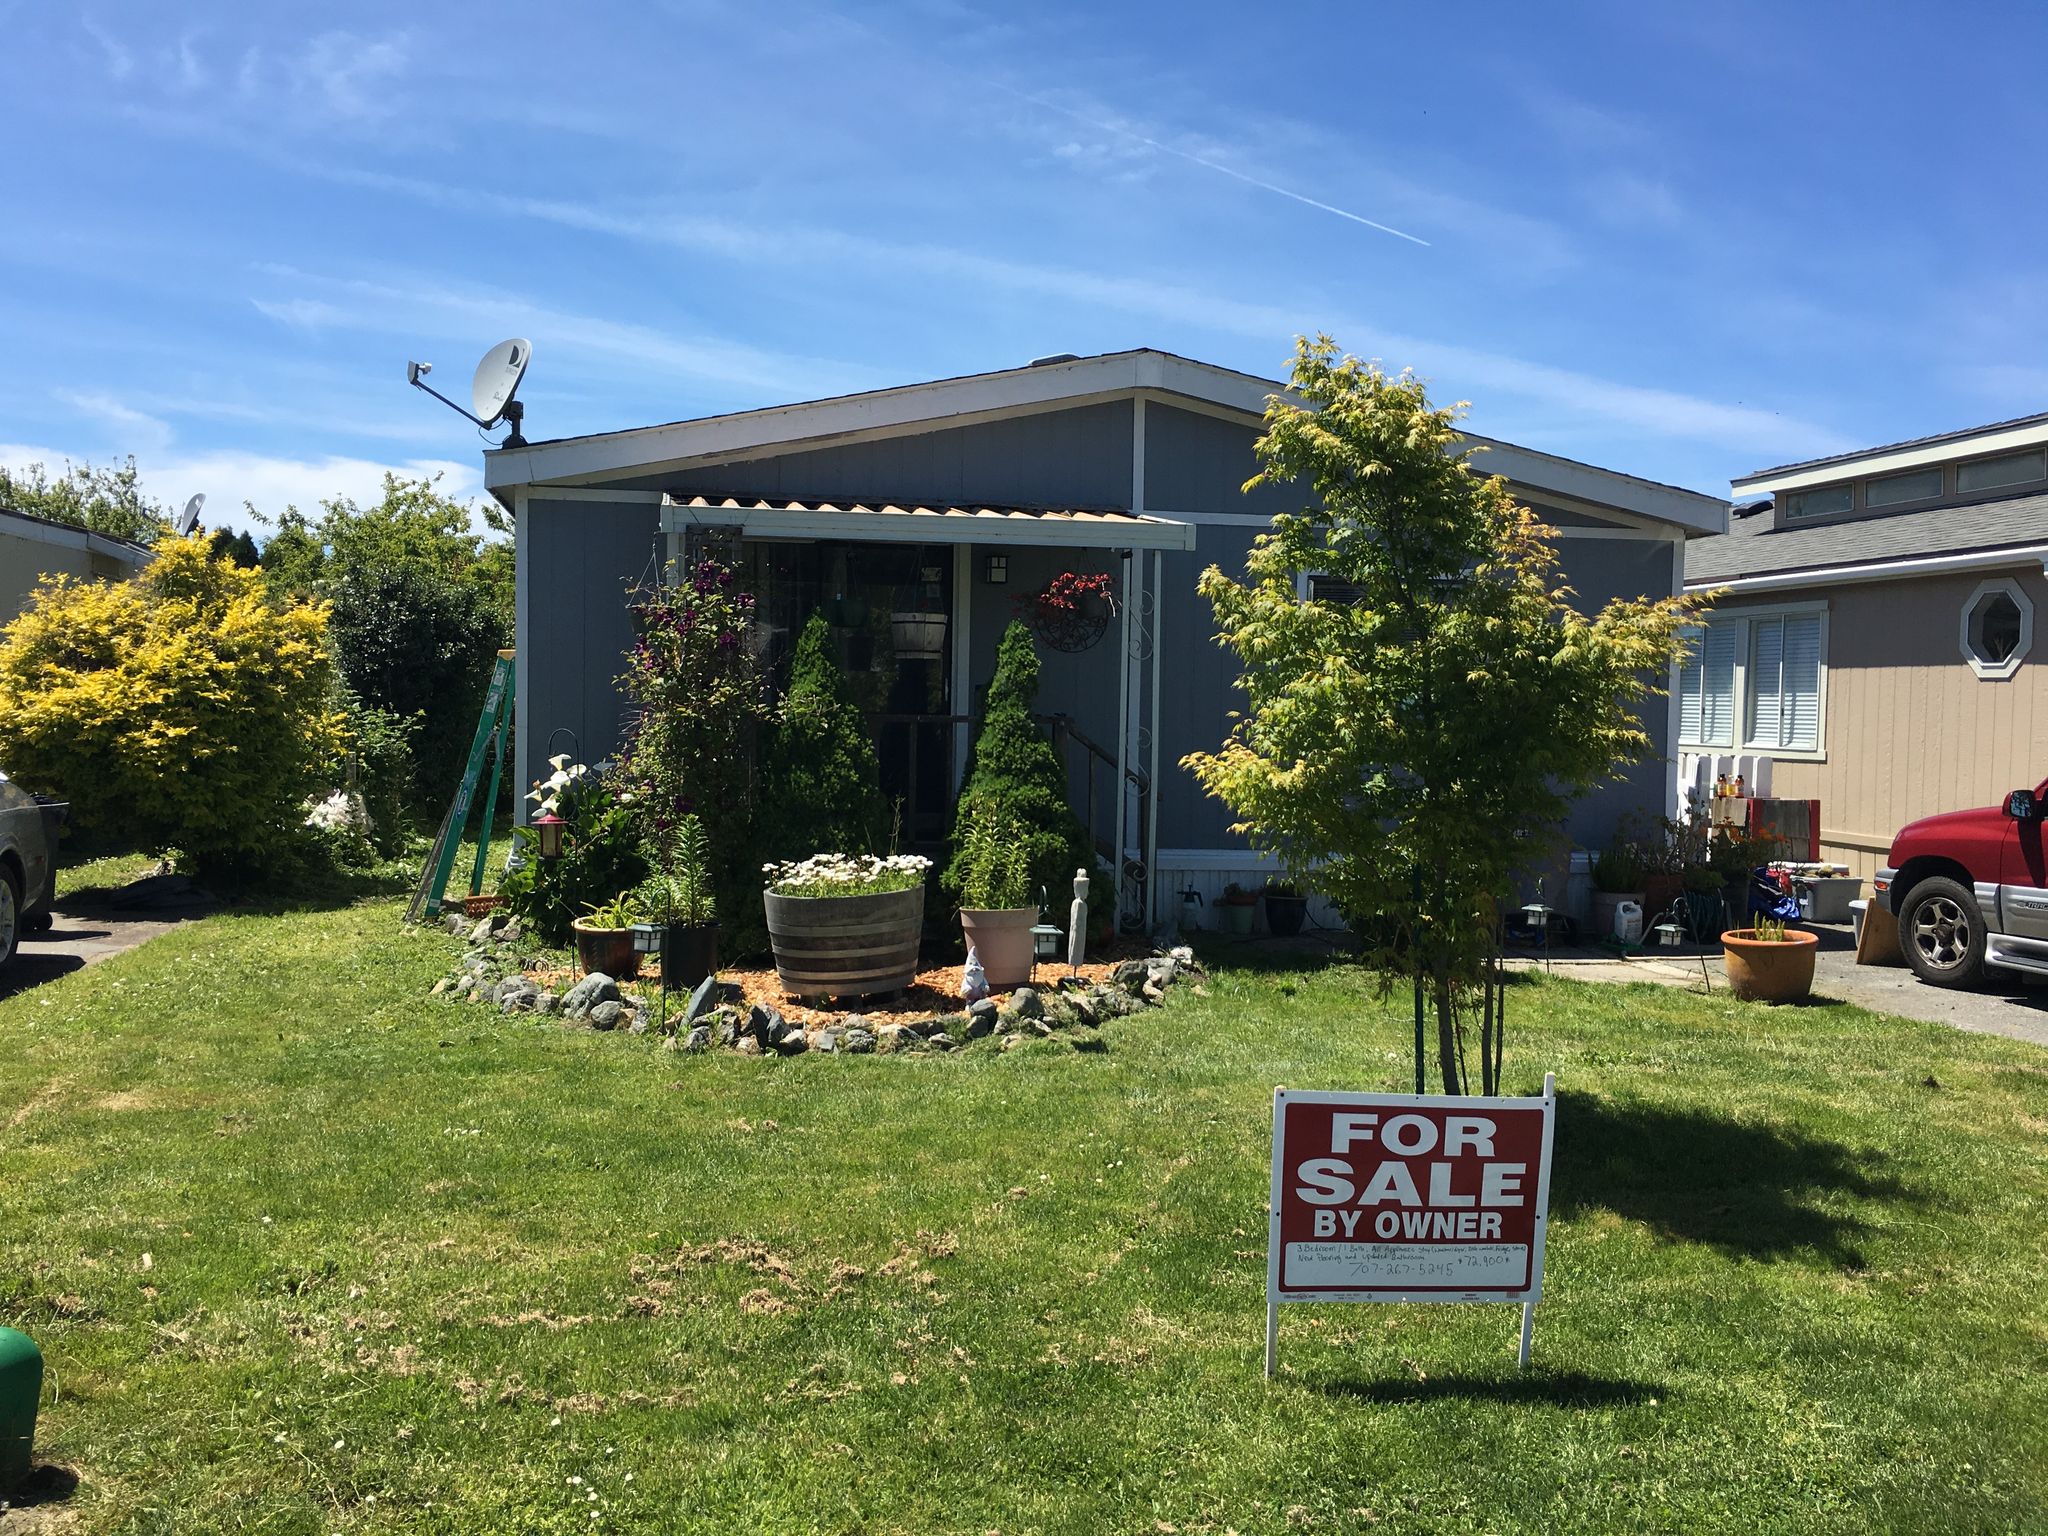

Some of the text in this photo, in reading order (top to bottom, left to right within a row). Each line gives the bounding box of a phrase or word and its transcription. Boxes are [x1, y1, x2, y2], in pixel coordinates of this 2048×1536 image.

[1331, 1112, 1497, 1157] FOR
[1295, 1158, 1527, 1207] SALE
[1314, 1209, 1503, 1239] BY OWNER
[1297, 1244, 1303, 1252] 3
[1304, 1244, 1336, 1252] Bedroom
[1349, 1262, 1454, 1277] 707-267-5245
